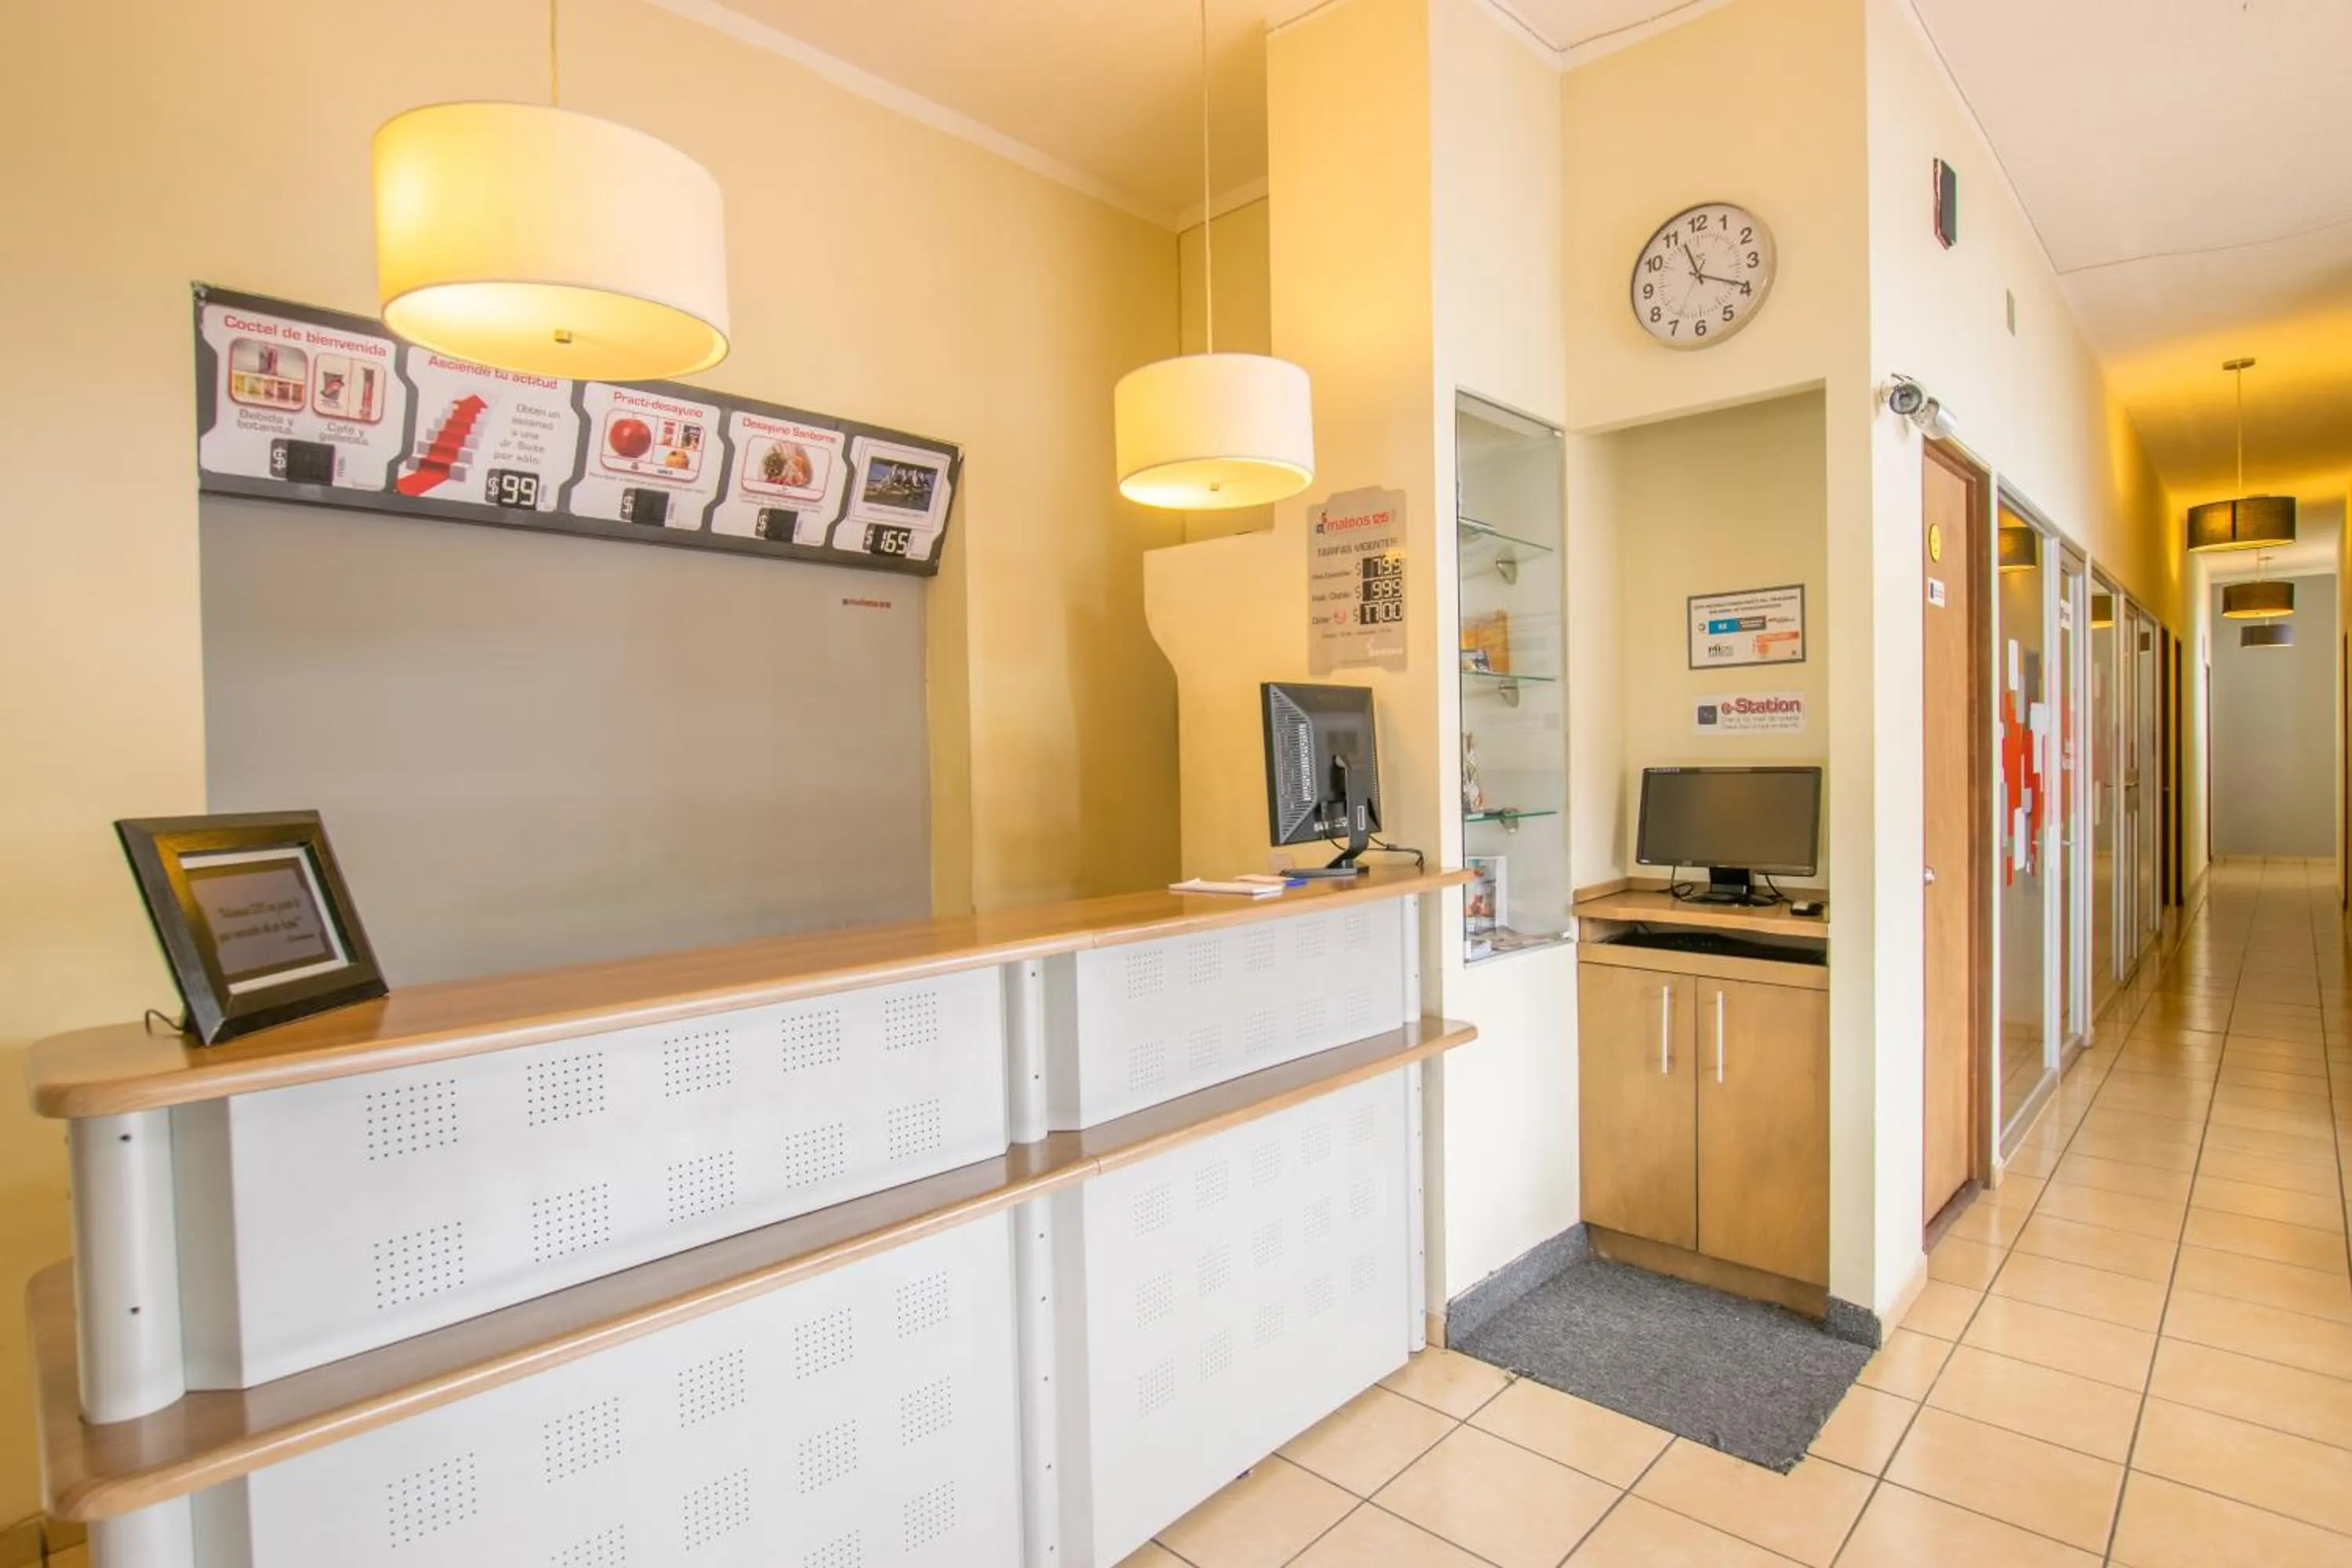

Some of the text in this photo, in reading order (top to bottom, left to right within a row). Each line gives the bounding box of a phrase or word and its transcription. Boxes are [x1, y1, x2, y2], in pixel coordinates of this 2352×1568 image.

[1687, 215, 1708, 233] 12
[1719, 214, 1727, 230] 1
[1663, 230, 1679, 248] 11
[1740, 227, 1753, 245] 2
[1646, 255, 1663, 272] 10
[1746, 252, 1759, 268] 3
[1642, 284, 1654, 299] 9
[1739, 281, 1752, 296] 4
[1650, 307, 1661, 322] 8
[1722, 304, 1734, 321] 5
[224, 314, 387, 357] Coctel de bienvenida
[1668, 320, 1679, 336] 7
[1694, 320, 1707, 336] 6
[429, 355, 558, 390] Asciende tu actitud
[614, 391, 703, 418] Practi-desayuno
[742, 417, 791, 436] Desayuno
[273, 446, 287, 470] $
[488, 476, 500, 497] $
[501, 474, 538, 506] 99
[880, 530, 909, 554] 165
[1721, 697, 1802, 715] e-Station
